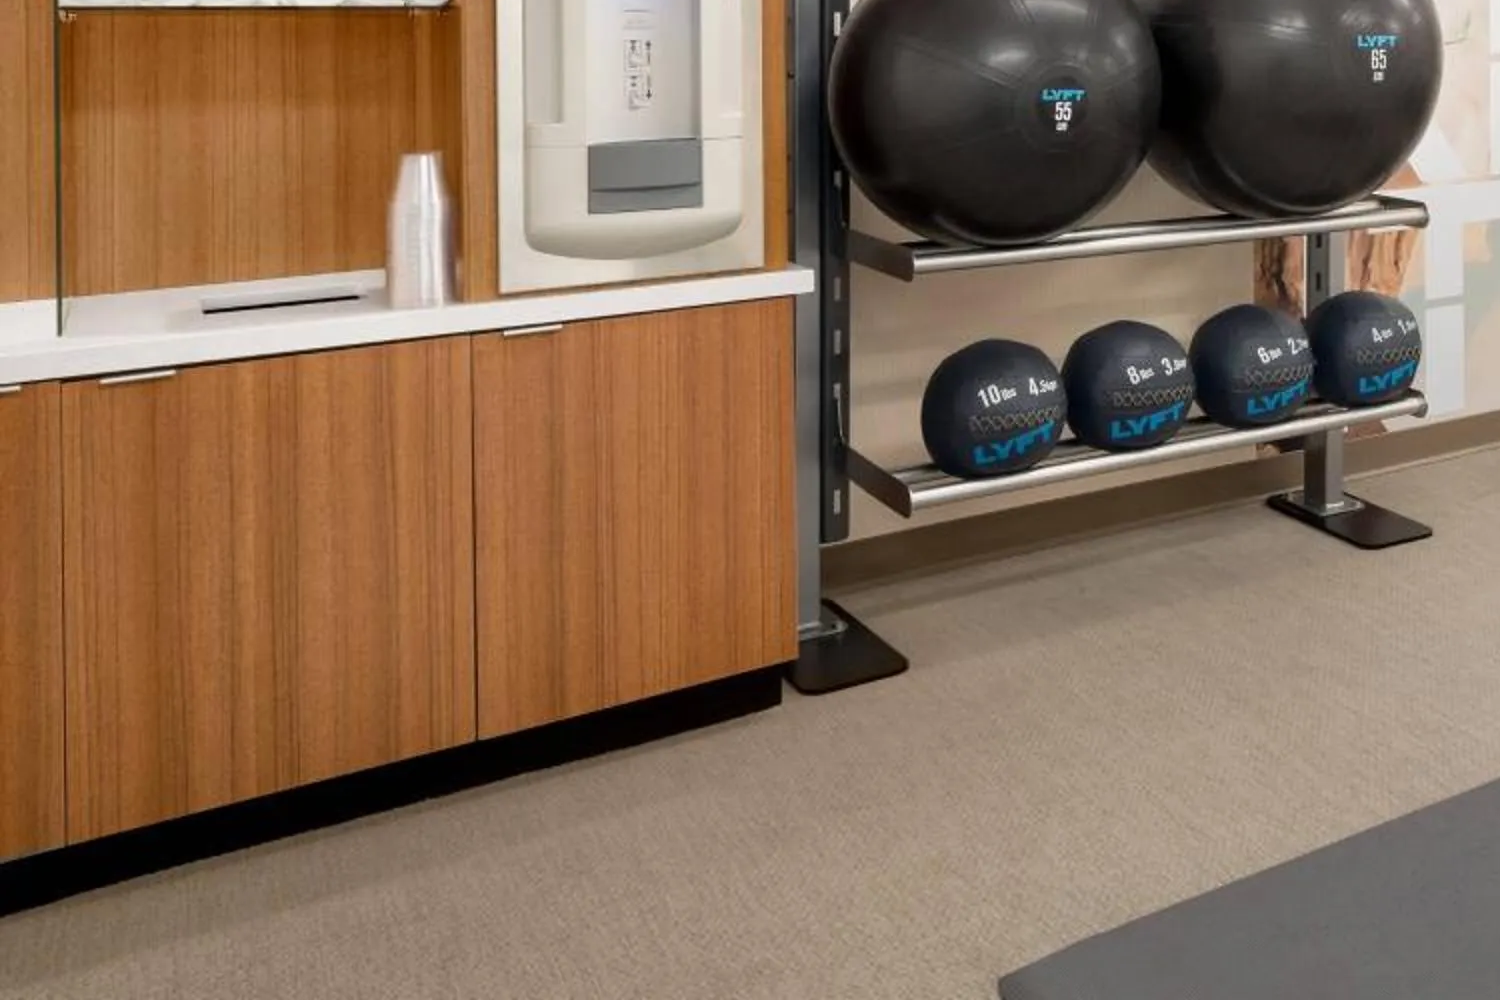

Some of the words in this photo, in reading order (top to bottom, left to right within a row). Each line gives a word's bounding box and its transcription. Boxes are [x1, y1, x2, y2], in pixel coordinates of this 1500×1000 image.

[1357, 34, 1397, 48] LYFT
[1371, 49, 1387, 70] 65
[1041, 88, 1085, 101] LYFT
[1055, 101, 1073, 121] 55
[1359, 361, 1416, 392] LYFT
[1247, 376, 1308, 415] LYFT
[1111, 401, 1185, 439] LYFT
[973, 418, 1056, 465] LYFT
